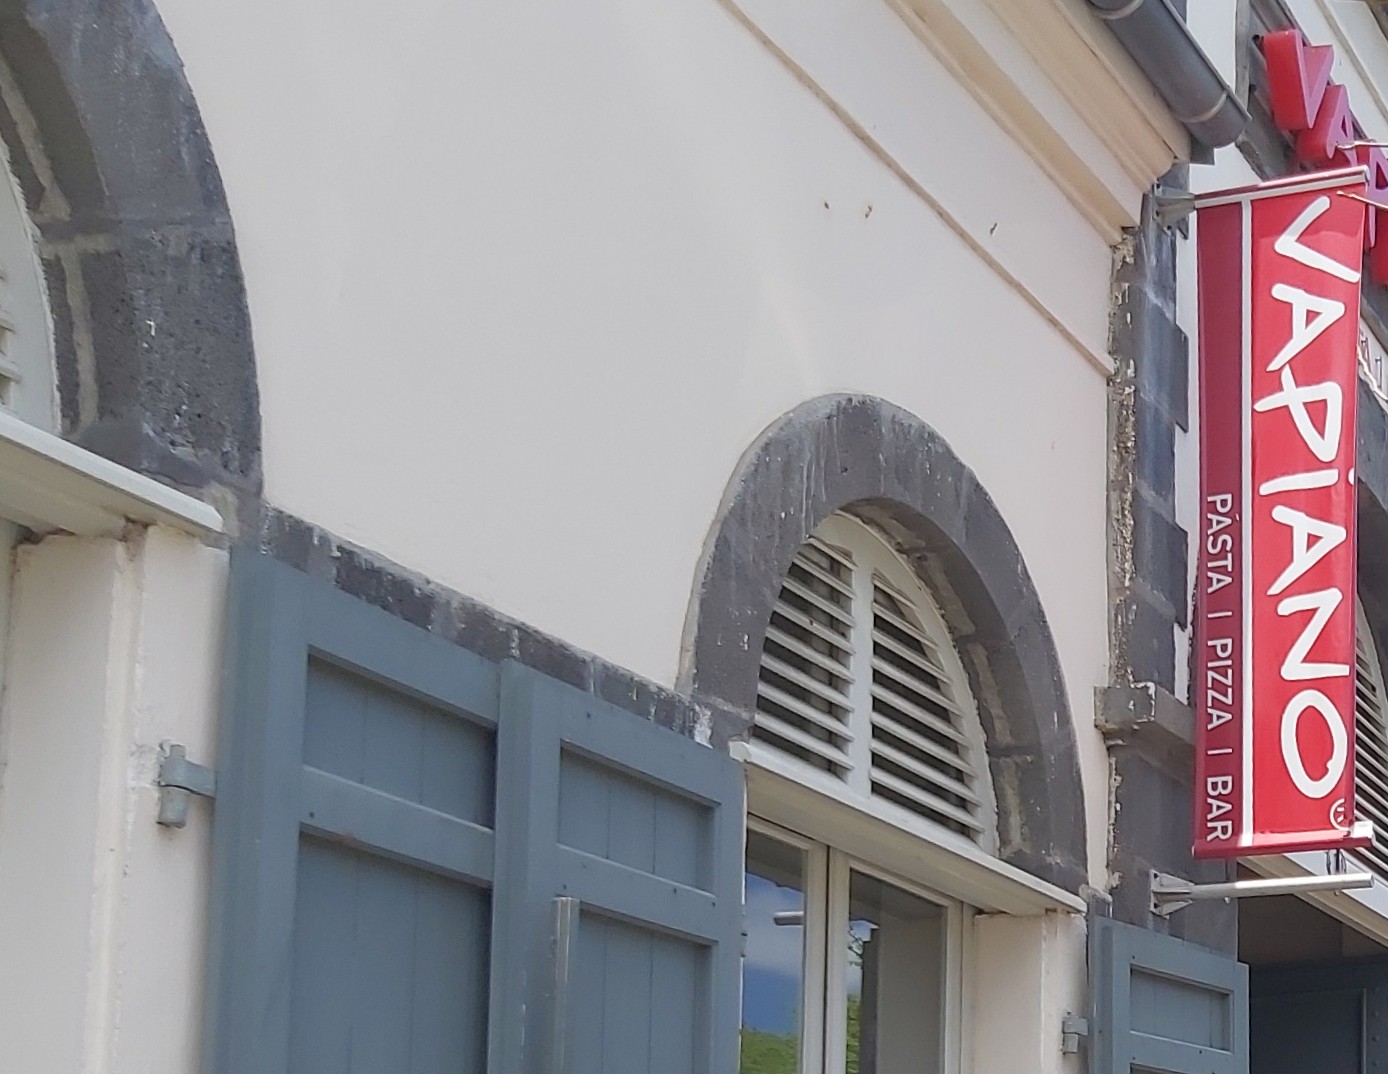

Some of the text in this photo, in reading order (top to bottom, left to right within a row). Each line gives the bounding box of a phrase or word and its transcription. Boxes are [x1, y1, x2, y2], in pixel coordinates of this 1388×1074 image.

[1206, 492, 1234, 594] PASTA
[1206, 638, 1234, 731] PIZZA
[1206, 774, 1234, 842] BAR
